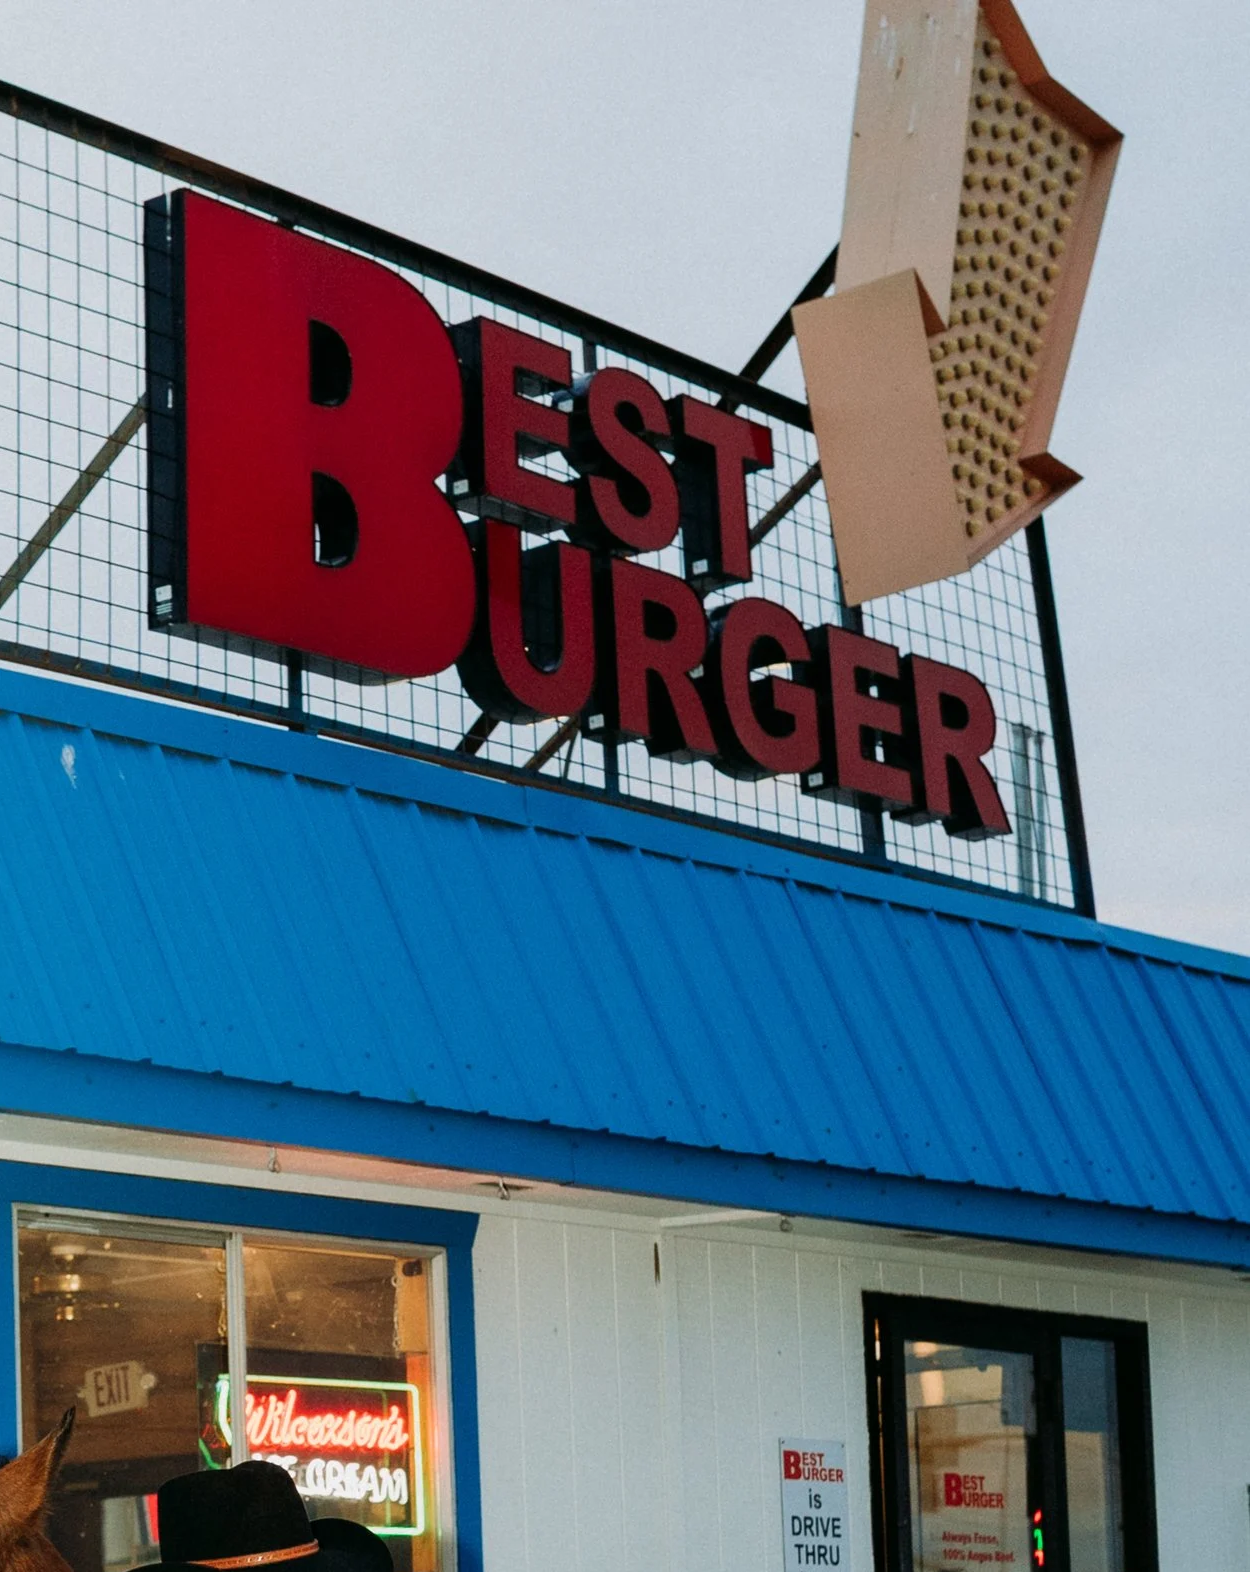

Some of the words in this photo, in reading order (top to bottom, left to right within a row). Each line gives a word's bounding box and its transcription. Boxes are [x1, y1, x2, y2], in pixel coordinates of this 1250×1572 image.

[94, 1366, 130, 1407] EXIT
[306, 1458, 408, 1505] CREAM
[808, 1488, 822, 1509] is
[791, 1515, 842, 1538] DRIVE
[794, 1544, 840, 1566] THRU
